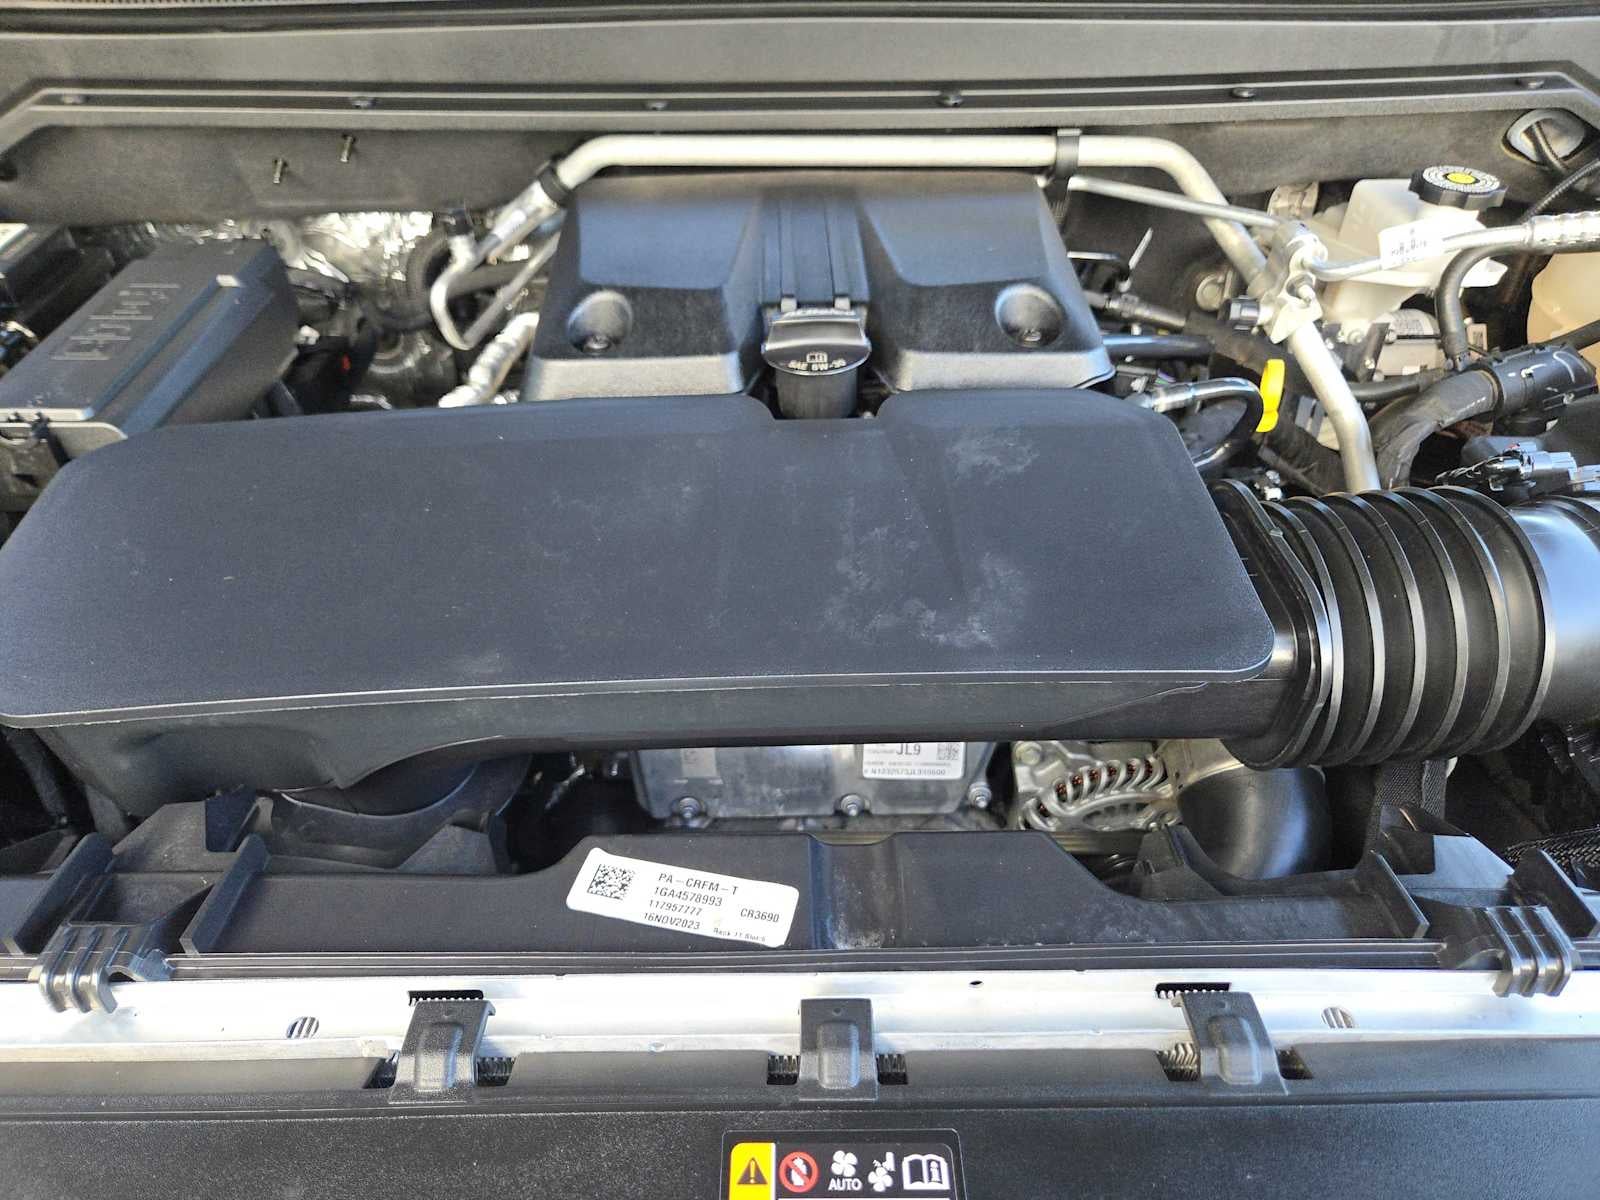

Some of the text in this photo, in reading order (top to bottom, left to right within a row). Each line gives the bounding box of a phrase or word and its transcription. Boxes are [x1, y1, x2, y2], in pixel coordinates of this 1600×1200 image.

[896, 743, 921, 756] JL9
[655, 886, 723, 907] 1GA4578993
[649, 899, 703, 917] 117957777
[740, 907, 780, 923] CR3690
[644, 912, 701, 930] 16NOV2023
[828, 1177, 863, 1191] AUTO
